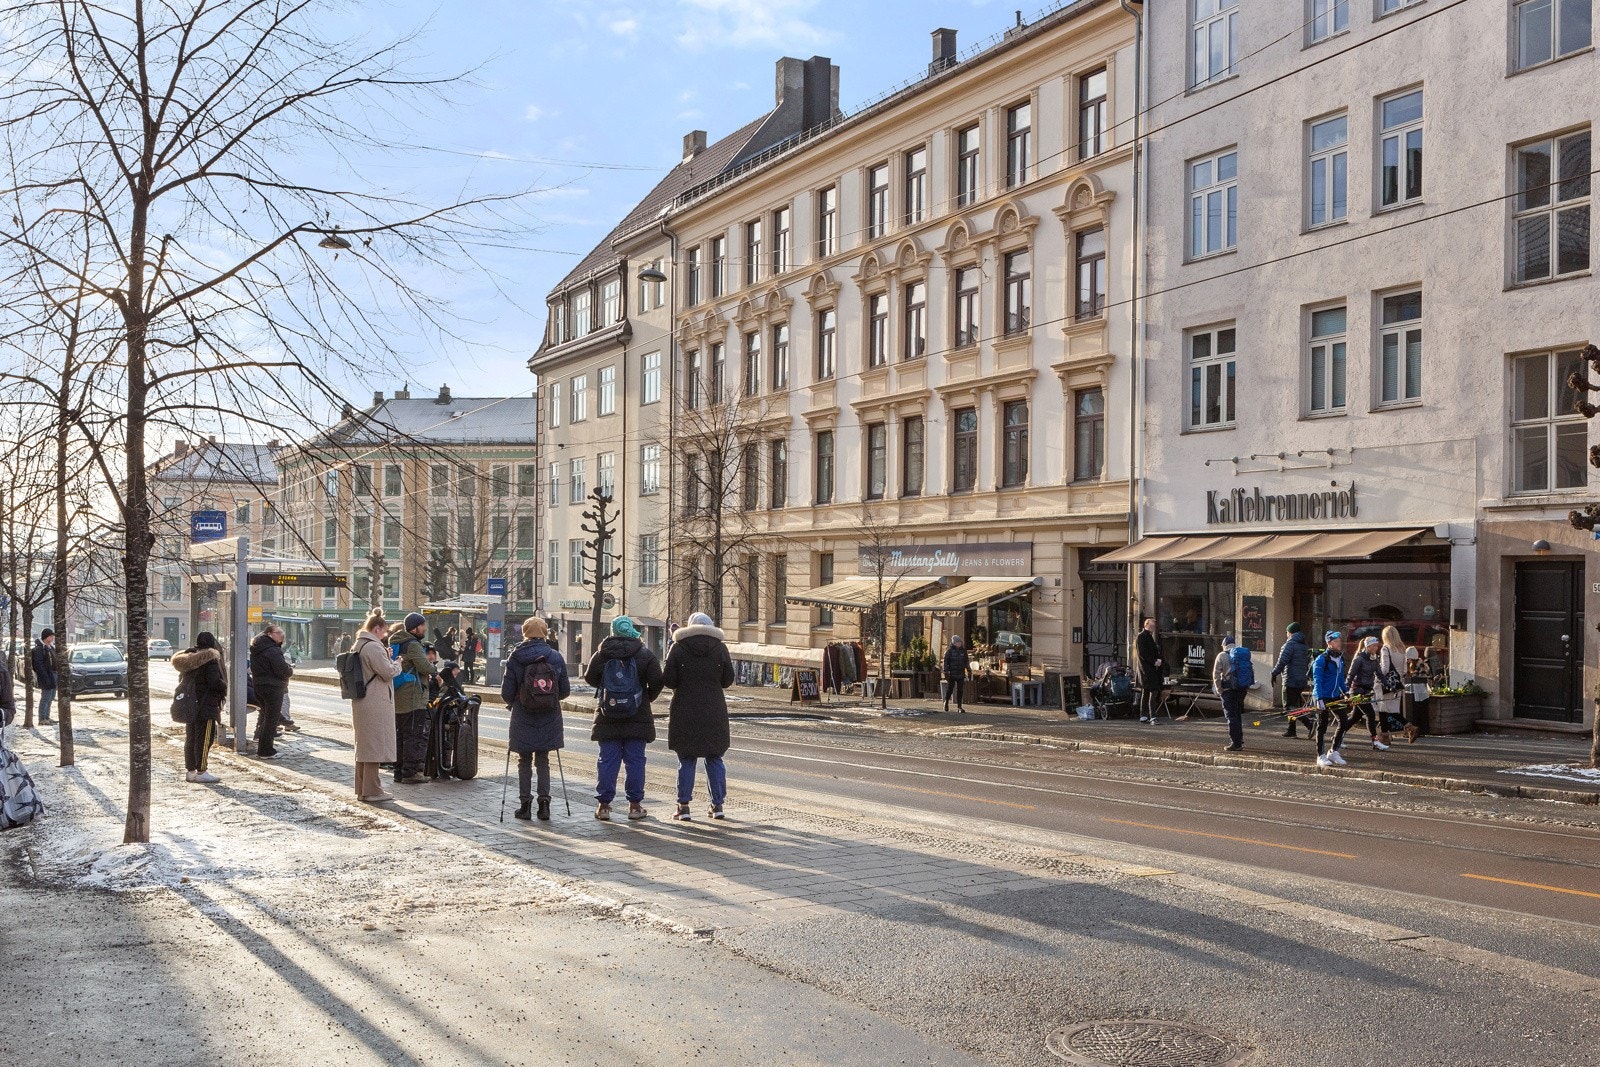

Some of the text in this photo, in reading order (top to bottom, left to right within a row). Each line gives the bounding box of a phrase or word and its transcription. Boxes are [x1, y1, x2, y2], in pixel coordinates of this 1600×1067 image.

[1206, 480, 1359, 524] Kaffebrenneriet
[961, 558, 982, 567] JEANS
[984, 558, 989, 566] &
[991, 558, 1025, 566] FLOWERS
[1188, 645, 1206, 658] Kaffe
